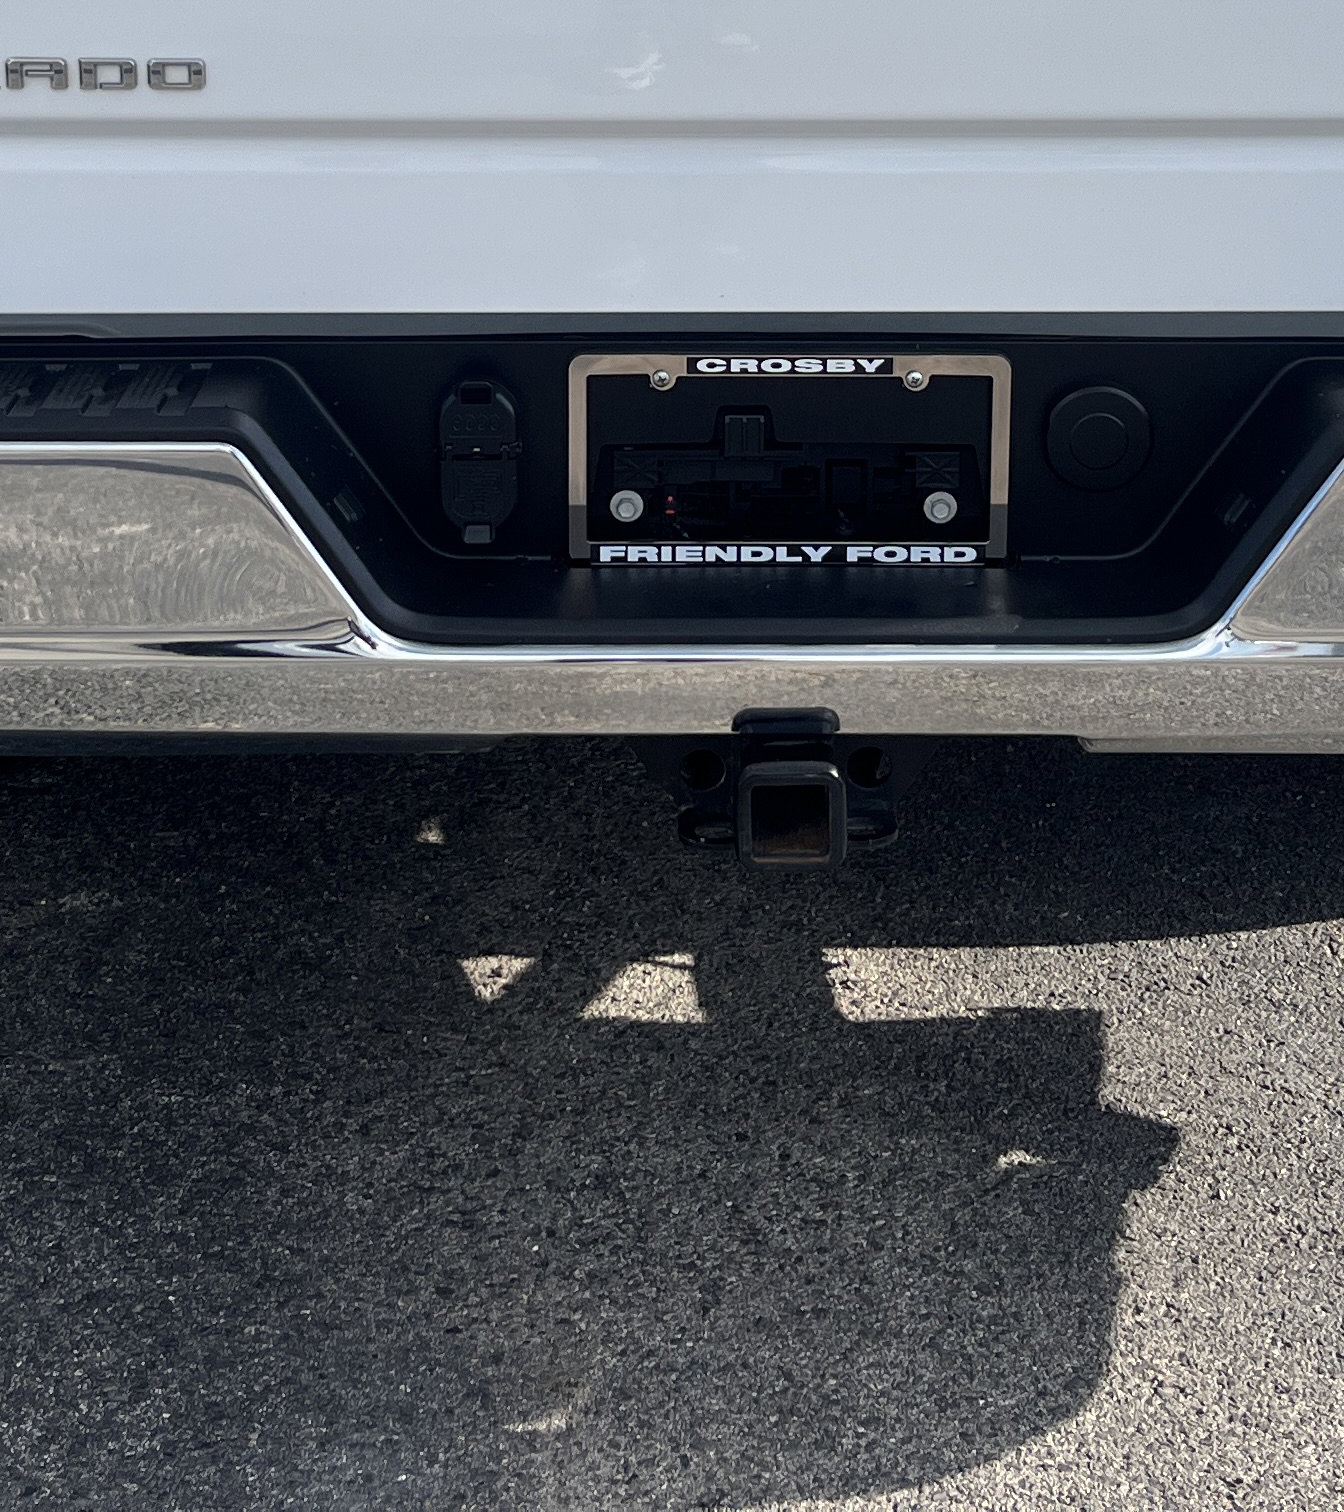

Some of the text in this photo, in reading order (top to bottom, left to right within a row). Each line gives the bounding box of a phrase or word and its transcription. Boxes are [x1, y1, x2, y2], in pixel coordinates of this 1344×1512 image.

[695, 357, 886, 374] CROSBY
[598, 545, 978, 563] FRIENDLY FORD
